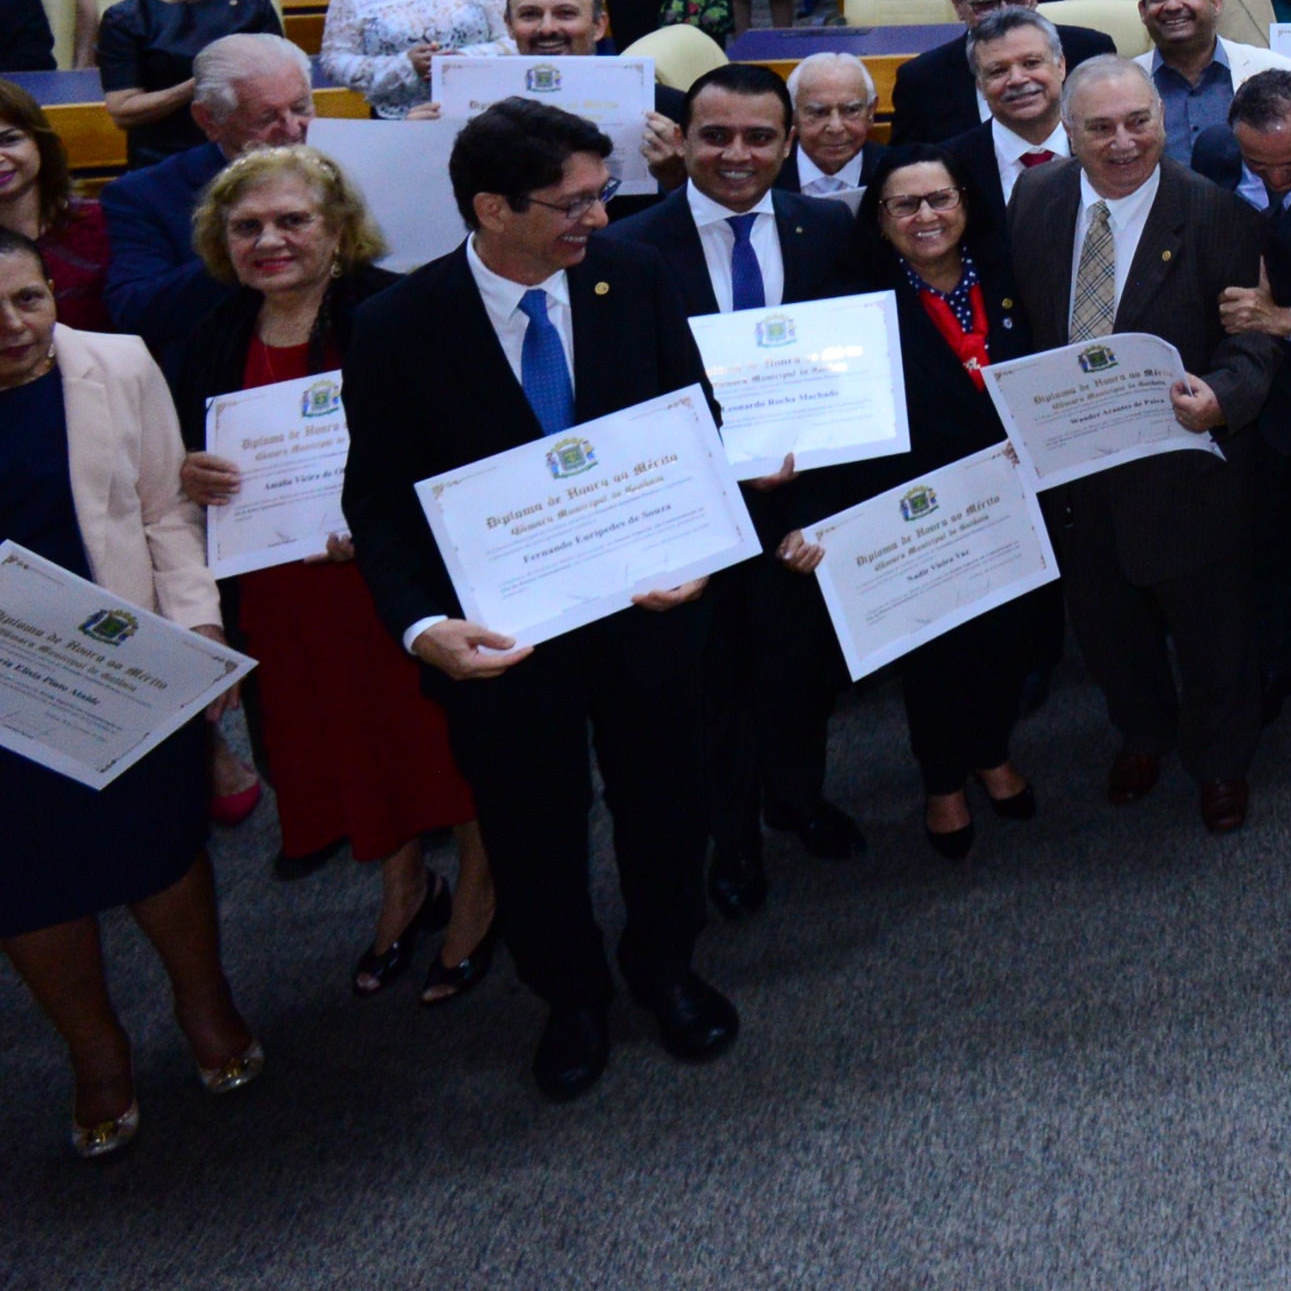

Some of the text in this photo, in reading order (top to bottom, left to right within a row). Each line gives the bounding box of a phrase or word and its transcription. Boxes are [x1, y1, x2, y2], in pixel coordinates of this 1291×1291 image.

[767, 394, 795, 406] Rocha
[798, 388, 838, 401] Machado
[1031, 370, 1141, 405] Diploma de Honra ao
[1069, 412, 1101, 424] Wander
[1101, 403, 1133, 415] Arantes
[1143, 396, 1165, 406] Paiva
[241, 419, 339, 452] Diploma de Honra
[295, 470, 320, 484] Vieira
[322, 467, 332, 478] de
[484, 448, 678, 531] Diploma de Honra ao Mérito
[555, 493, 608, 521] Municipal
[609, 488, 622, 500] de
[521, 537, 574, 565] Fernando
[625, 512, 641, 525] de
[640, 500, 672, 519] Souza
[854, 491, 1000, 568] Diploma de Honra ao Mérito
[906, 547, 970, 583] Nadir Vieira Vaz
[44, 632, 65, 645] de
[63, 639, 107, 664] Honra
[104, 657, 126, 671] ao
[122, 664, 171, 691] Mérito
[40, 675, 70, 692] Pinto
